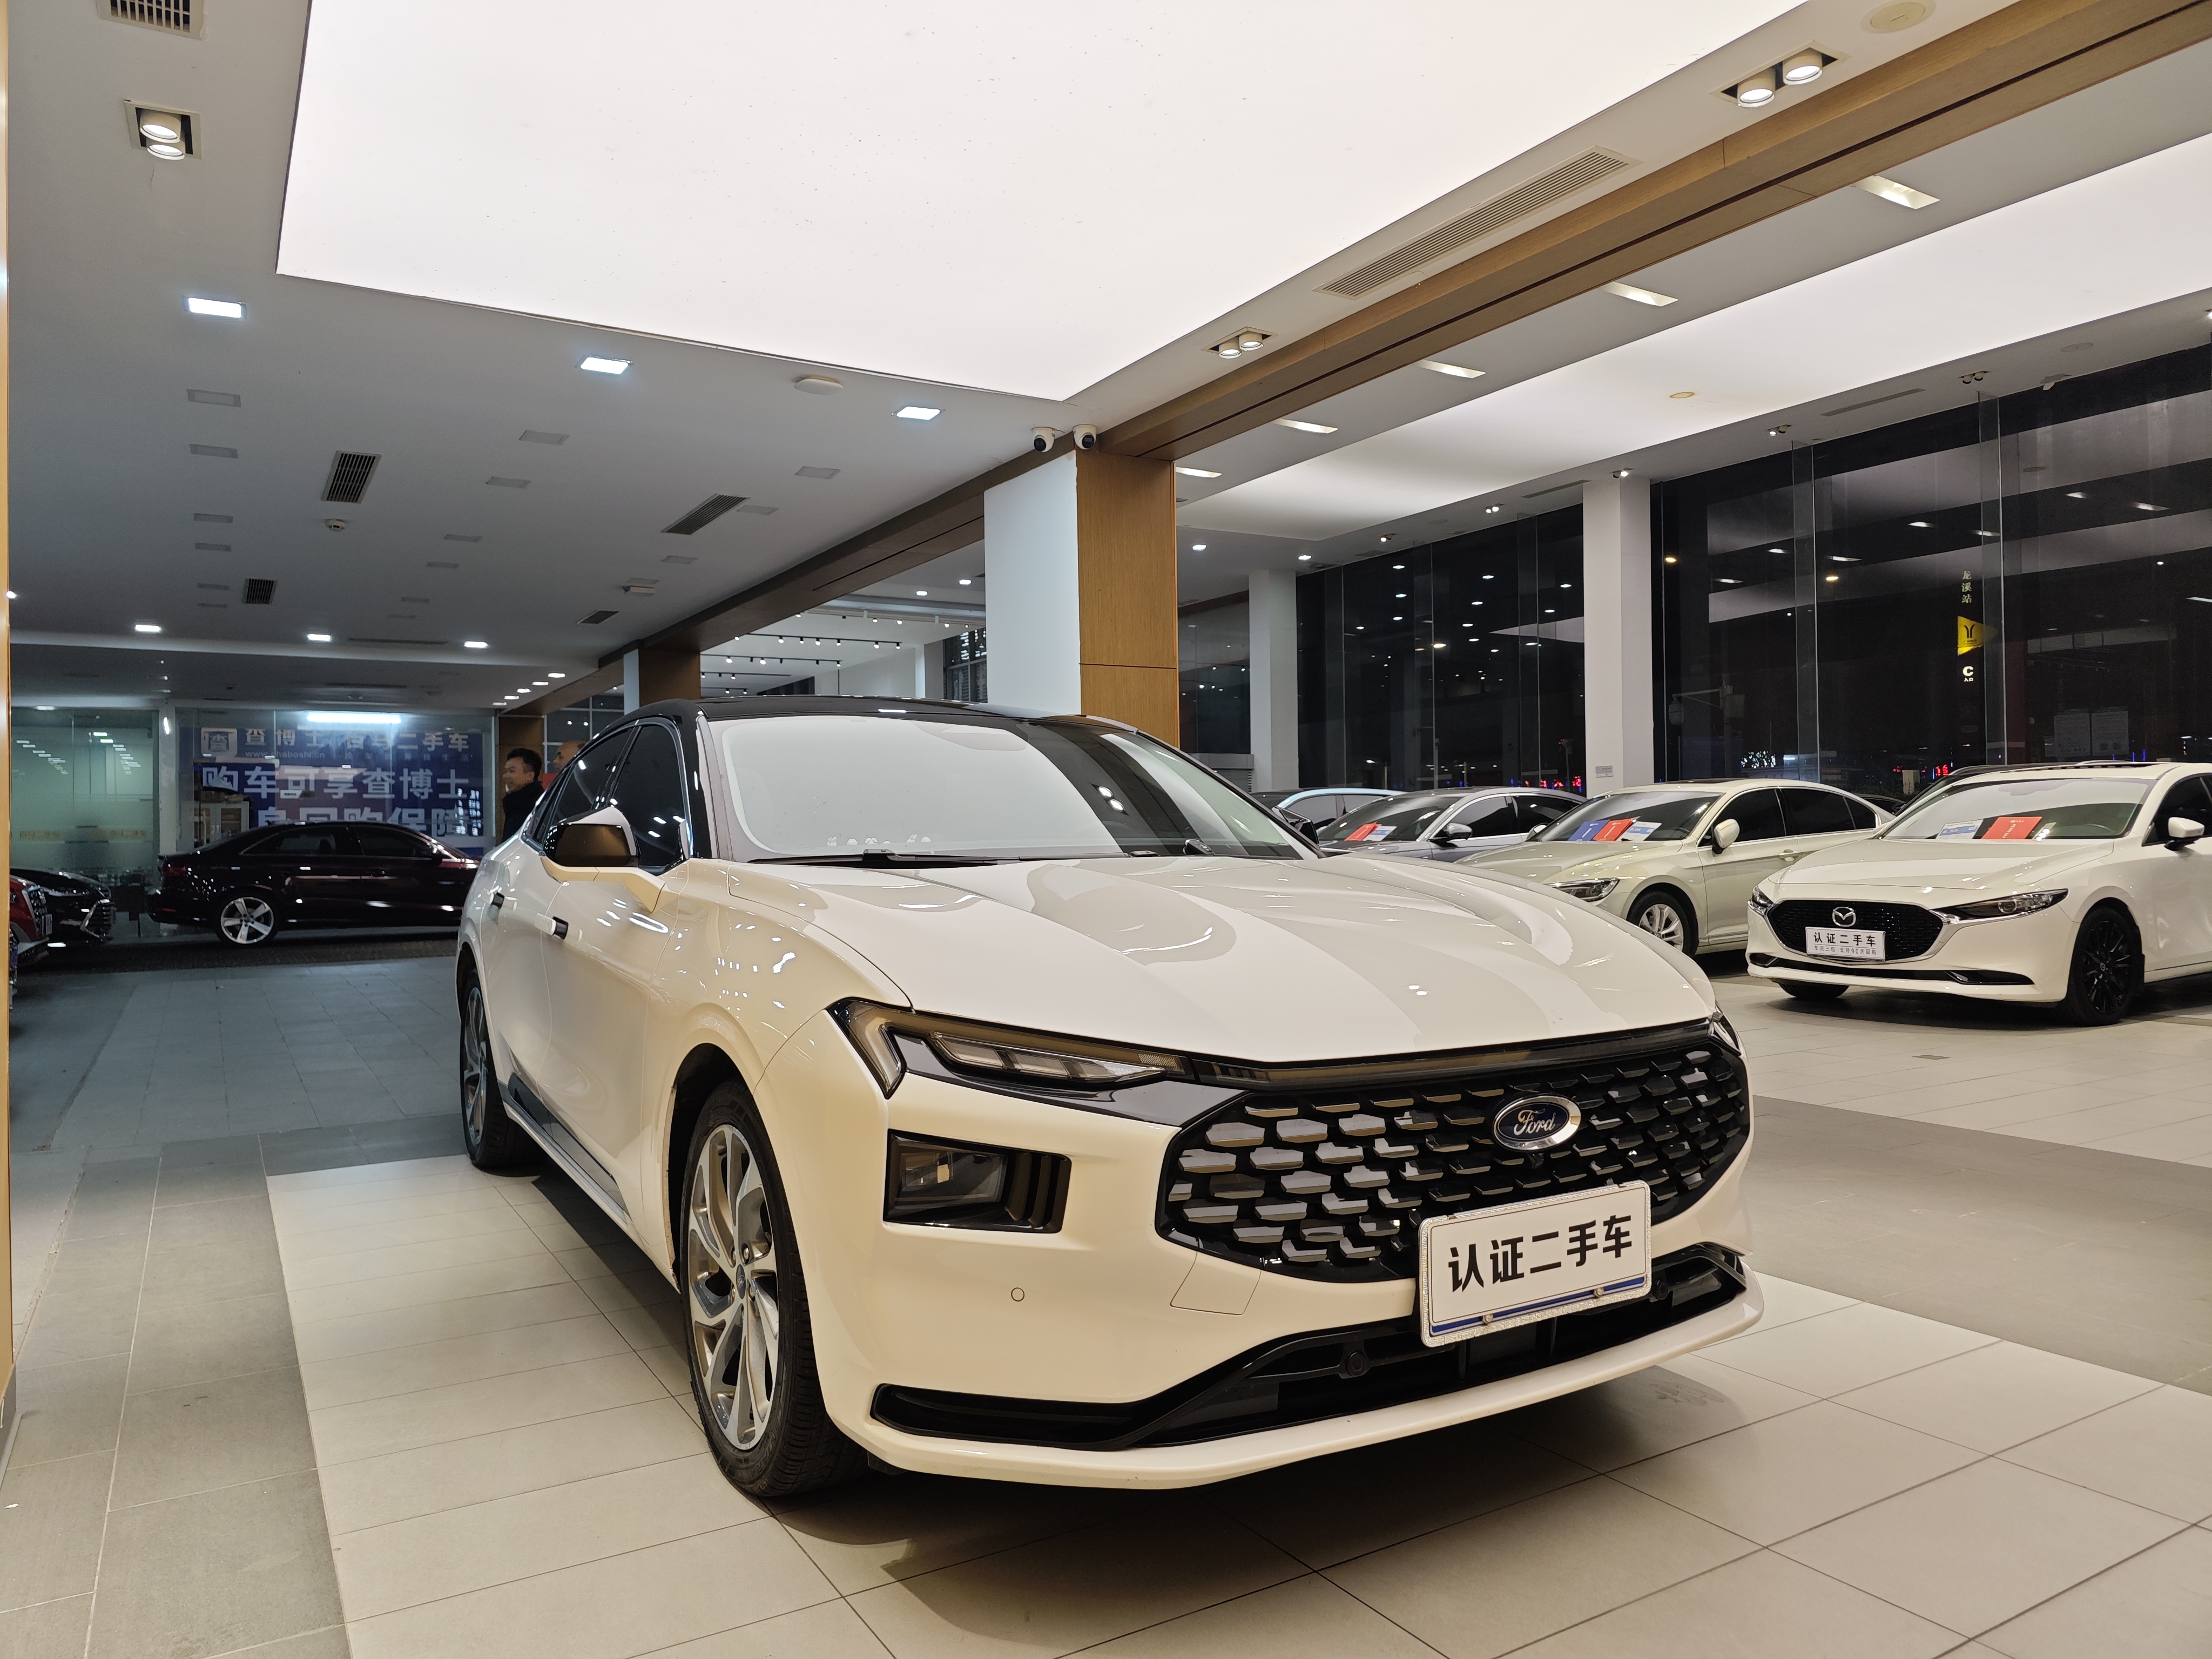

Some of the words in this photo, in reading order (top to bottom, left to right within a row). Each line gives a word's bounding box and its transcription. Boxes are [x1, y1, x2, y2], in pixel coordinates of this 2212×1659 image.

[1963, 666, 1974, 677] C
[203, 765, 469, 800] 购车可享查博士
[1813, 932, 1876, 947] 认证二手车
[1513, 1108, 1555, 1135] Ford
[1448, 1215, 1632, 1292] 认证二手车
